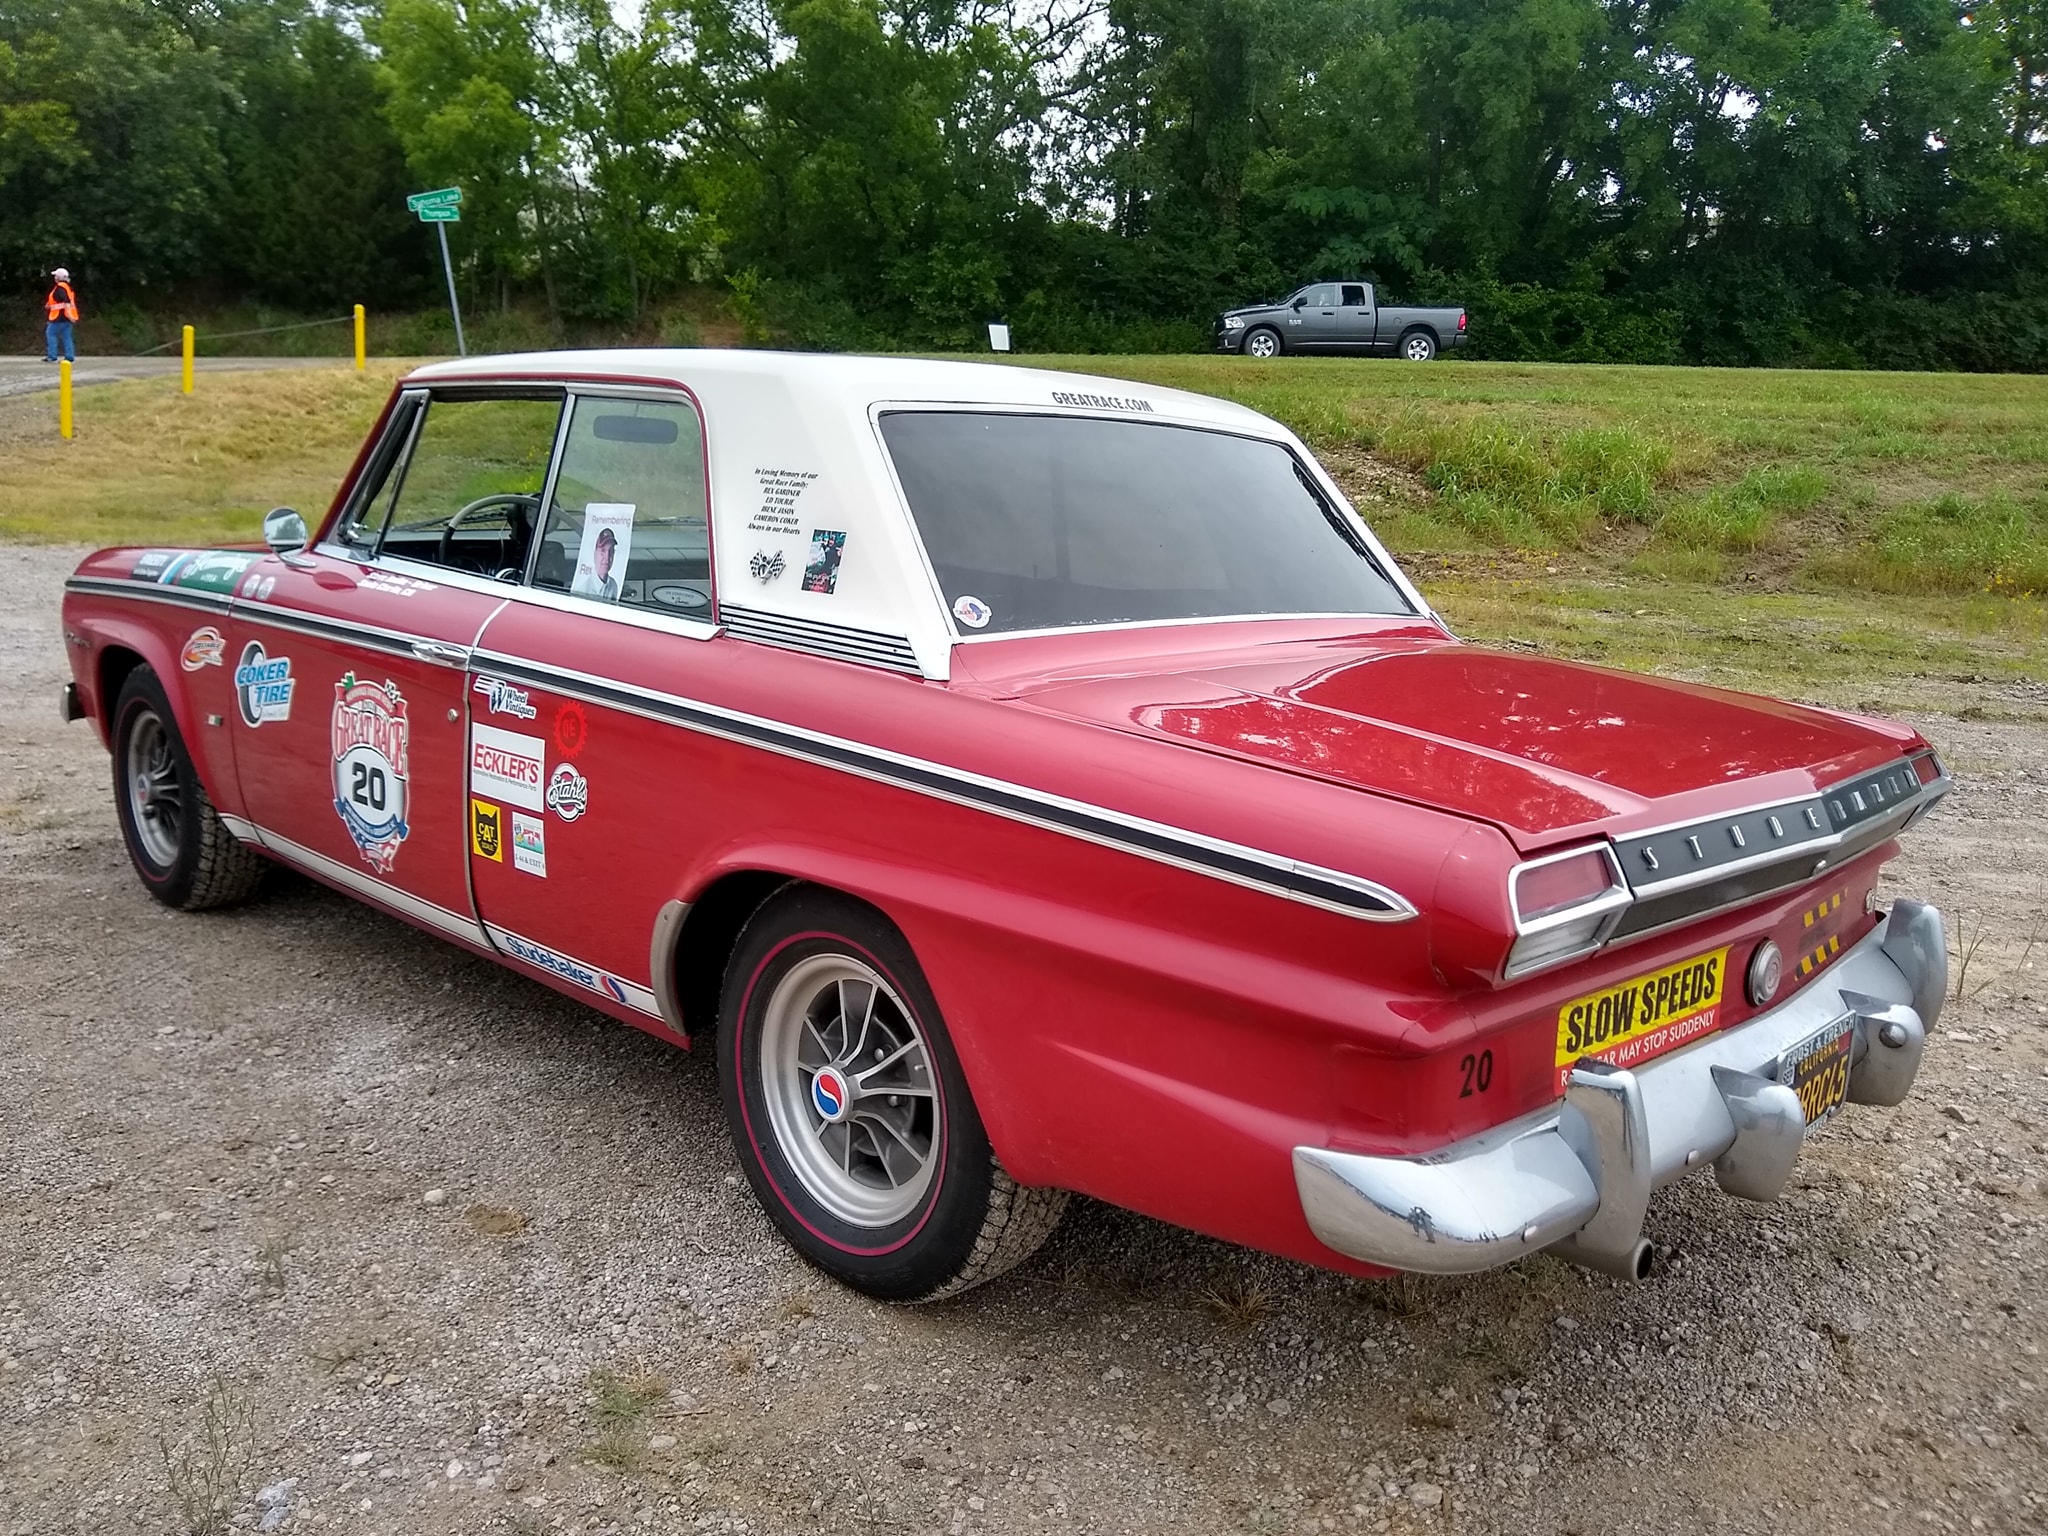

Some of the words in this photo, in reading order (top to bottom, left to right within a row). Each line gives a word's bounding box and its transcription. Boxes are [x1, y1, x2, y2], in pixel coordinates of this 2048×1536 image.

[1052, 391, 1154, 412] GREATRACE.COM
[760, 478, 775, 486] Great
[775, 479, 789, 487] Race
[761, 468, 779, 477] Loving
[780, 470, 800, 479] Memory
[765, 496, 773, 504] ED
[775, 488, 801, 497] GARDNER
[592, 515, 631, 528] Remembering
[747, 522, 765, 531] Always
[782, 526, 801, 535] Hearts
[753, 514, 779, 523] CAMERON
[779, 517, 799, 525] COKER
[236, 661, 288, 685] COKER
[255, 683, 291, 704] TIRE
[507, 688, 528, 704] Wheel
[505, 699, 535, 717] Vintiques
[335, 703, 375, 759] GREAT
[473, 743, 539, 784] ECKLER'S
[352, 762, 385, 811] 20
[1641, 769, 1917, 871] STUDEBAKER
[478, 822, 496, 843] CAT
[505, 936, 596, 988] Studebaker
[1566, 985, 1639, 1054] SLOW
[1640, 957, 1718, 1026] SPEEDS
[1618, 1039, 1642, 1064] MAY
[1643, 1029, 1668, 1053] STOP
[1669, 1009, 1715, 1042] SUDDENLY
[1823, 1014, 1855, 1044] FRENCH
[1799, 1038, 1840, 1076] CALIFORNIA
[1459, 1049, 1493, 1099] 20
